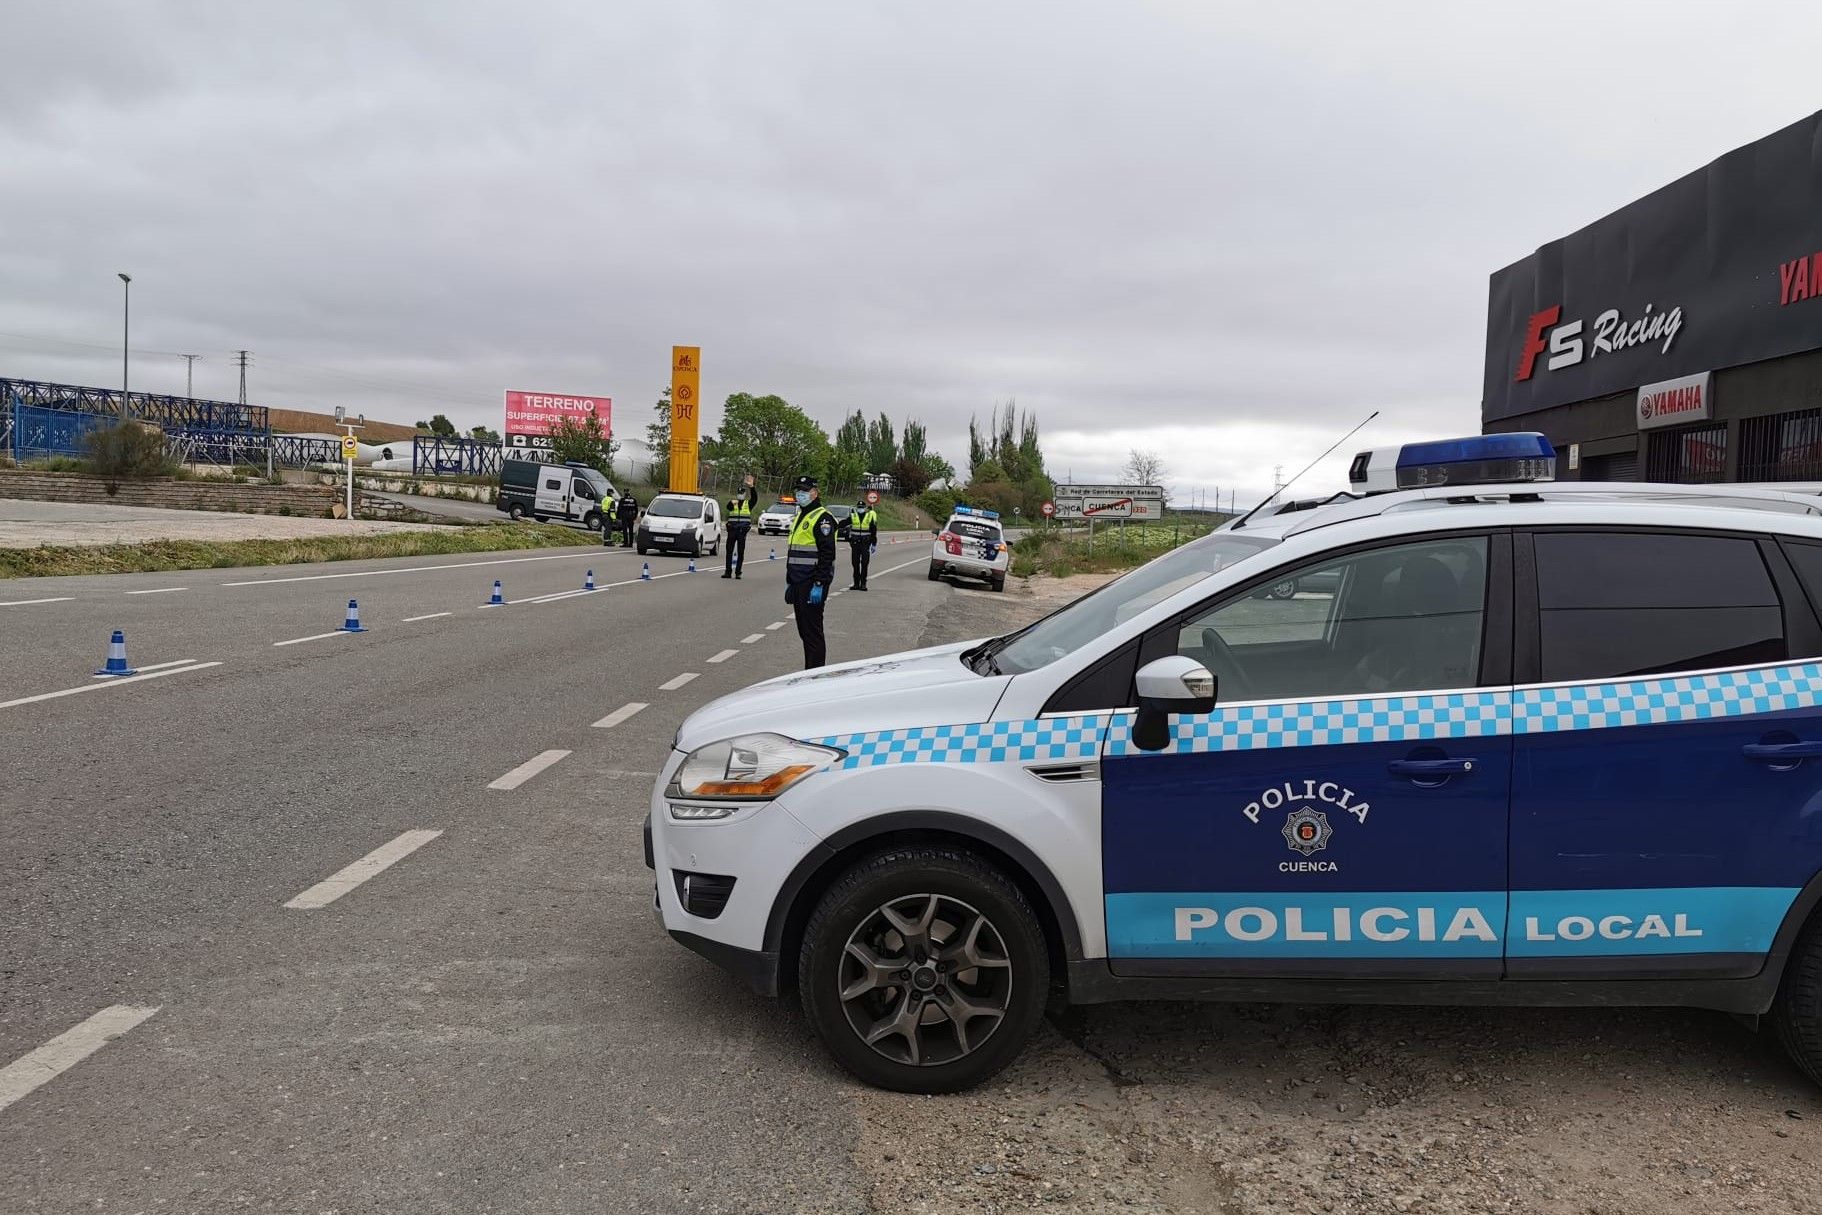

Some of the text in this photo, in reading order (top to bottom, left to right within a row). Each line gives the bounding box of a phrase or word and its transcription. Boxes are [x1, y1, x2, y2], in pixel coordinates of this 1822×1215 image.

[1590, 302, 1683, 359] Racing
[524, 396, 594, 411] TERRENO
[1651, 383, 1702, 418] YAMAHA
[1089, 503, 1126, 511] CUENCA
[1242, 779, 1371, 825] POLICIA
[1279, 861, 1338, 872] CUENCA
[1174, 907, 1703, 943] POLICIA LOCAL
